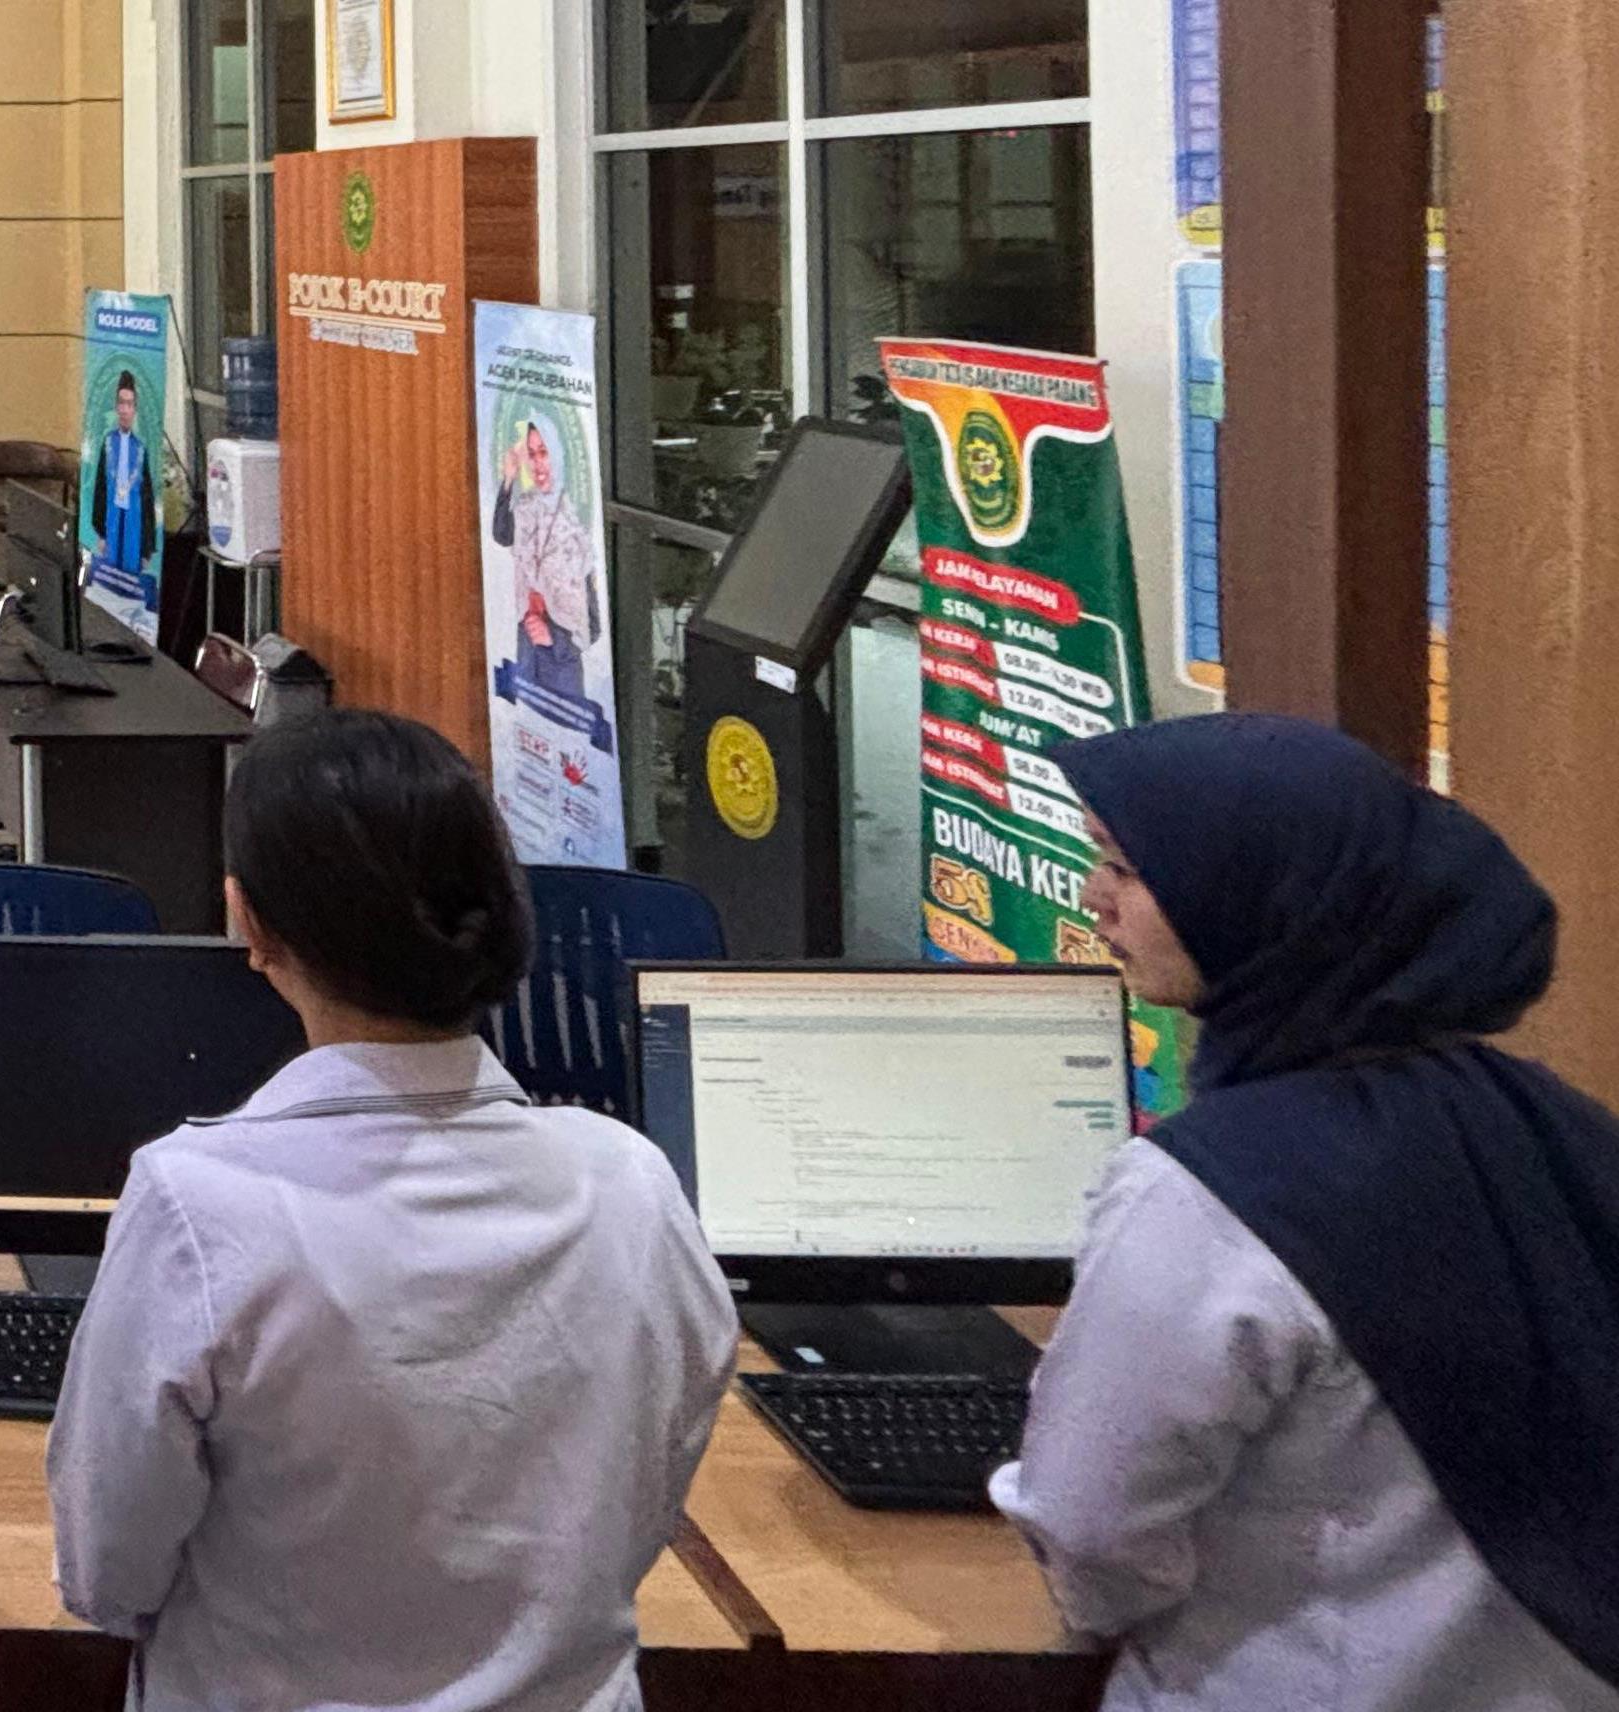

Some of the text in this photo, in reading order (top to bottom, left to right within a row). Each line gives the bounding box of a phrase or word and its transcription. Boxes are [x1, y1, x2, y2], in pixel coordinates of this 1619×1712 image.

[98, 313, 159, 332] ROLE MODEL
[933, 807, 1025, 888] BUDAYA
